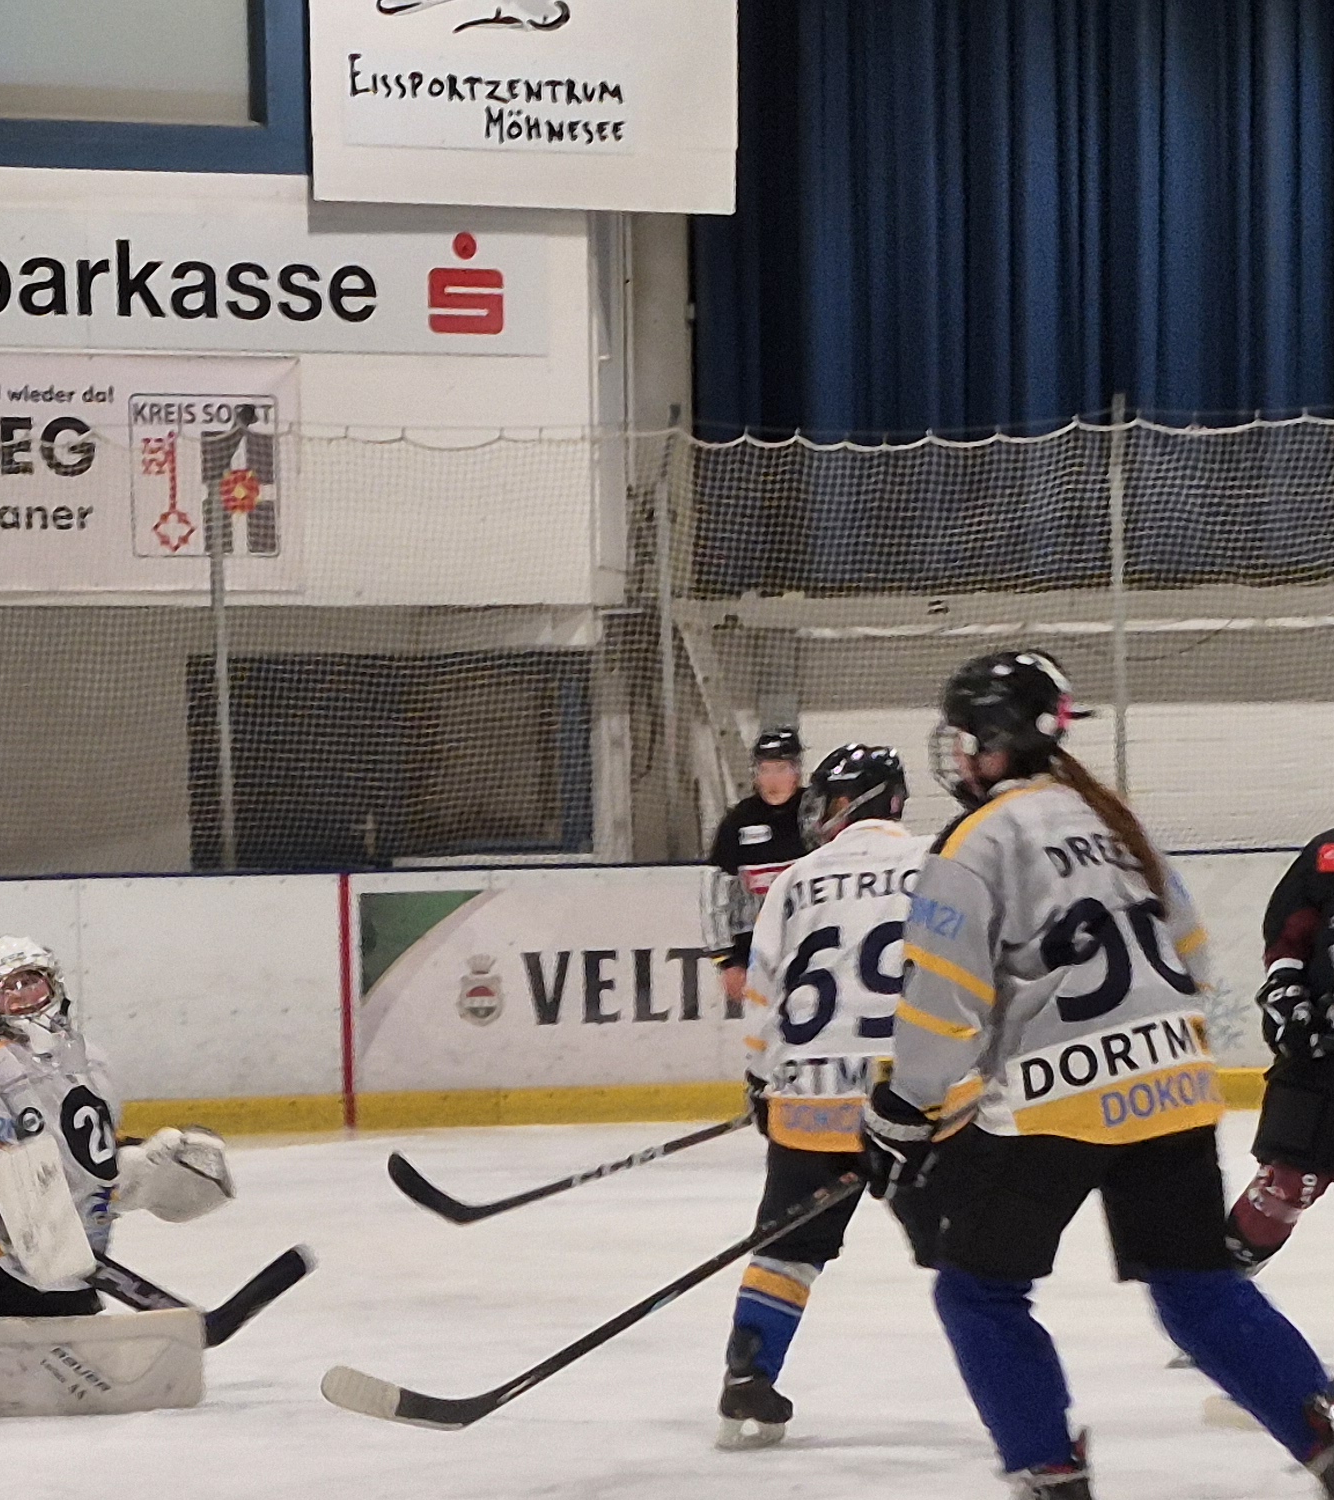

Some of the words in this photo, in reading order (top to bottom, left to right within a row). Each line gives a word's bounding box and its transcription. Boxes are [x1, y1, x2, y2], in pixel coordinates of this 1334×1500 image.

[484, 106, 628, 145] MÖHNESEE
[7, 384, 77, 403] wieder
[133, 402, 198, 425] KREIS
[201, 403, 274, 425] SOT
[1020, 1016, 1210, 1101] DORTM
